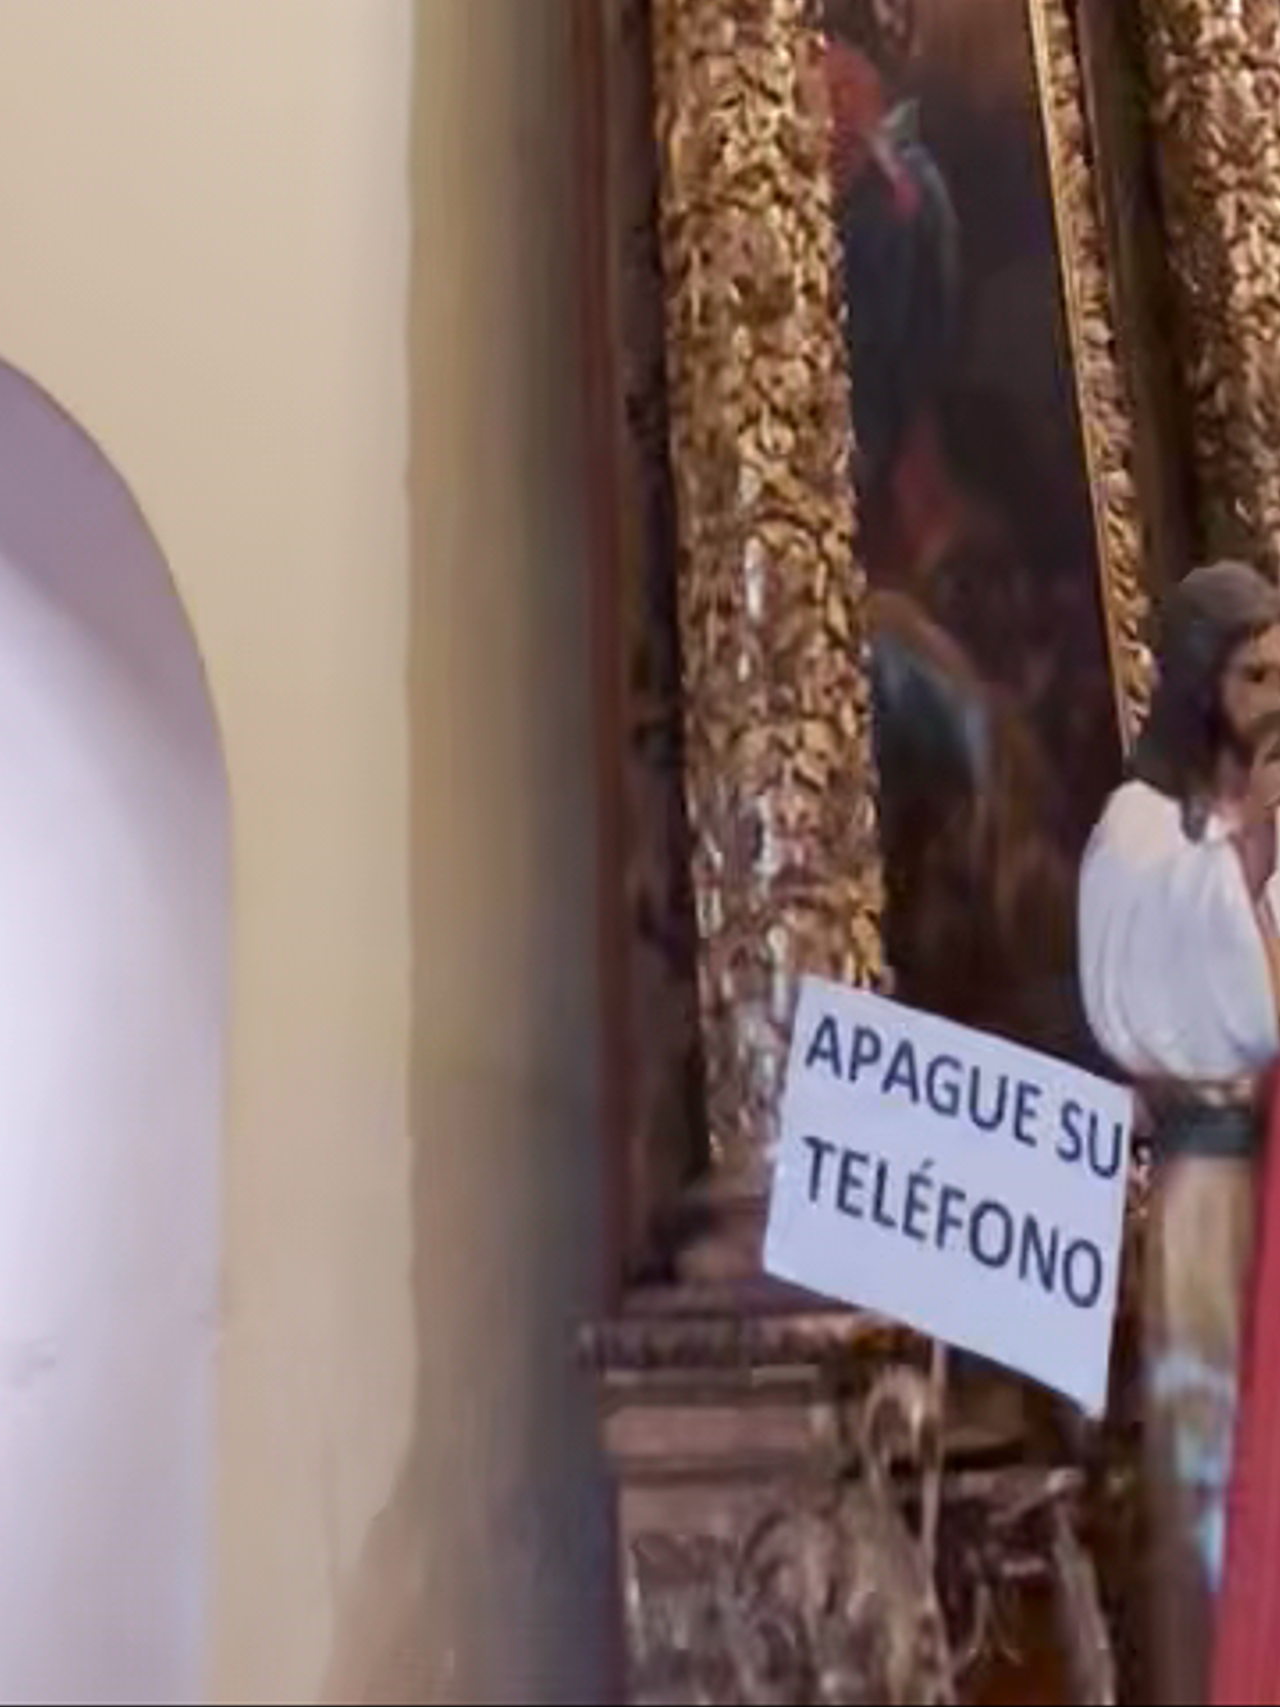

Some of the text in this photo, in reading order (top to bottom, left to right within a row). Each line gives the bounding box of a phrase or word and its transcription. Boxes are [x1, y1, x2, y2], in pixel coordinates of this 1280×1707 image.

[804, 1014, 1123, 1179] APAGUE SU
[804, 1135, 1103, 1309] TELÉFONO
